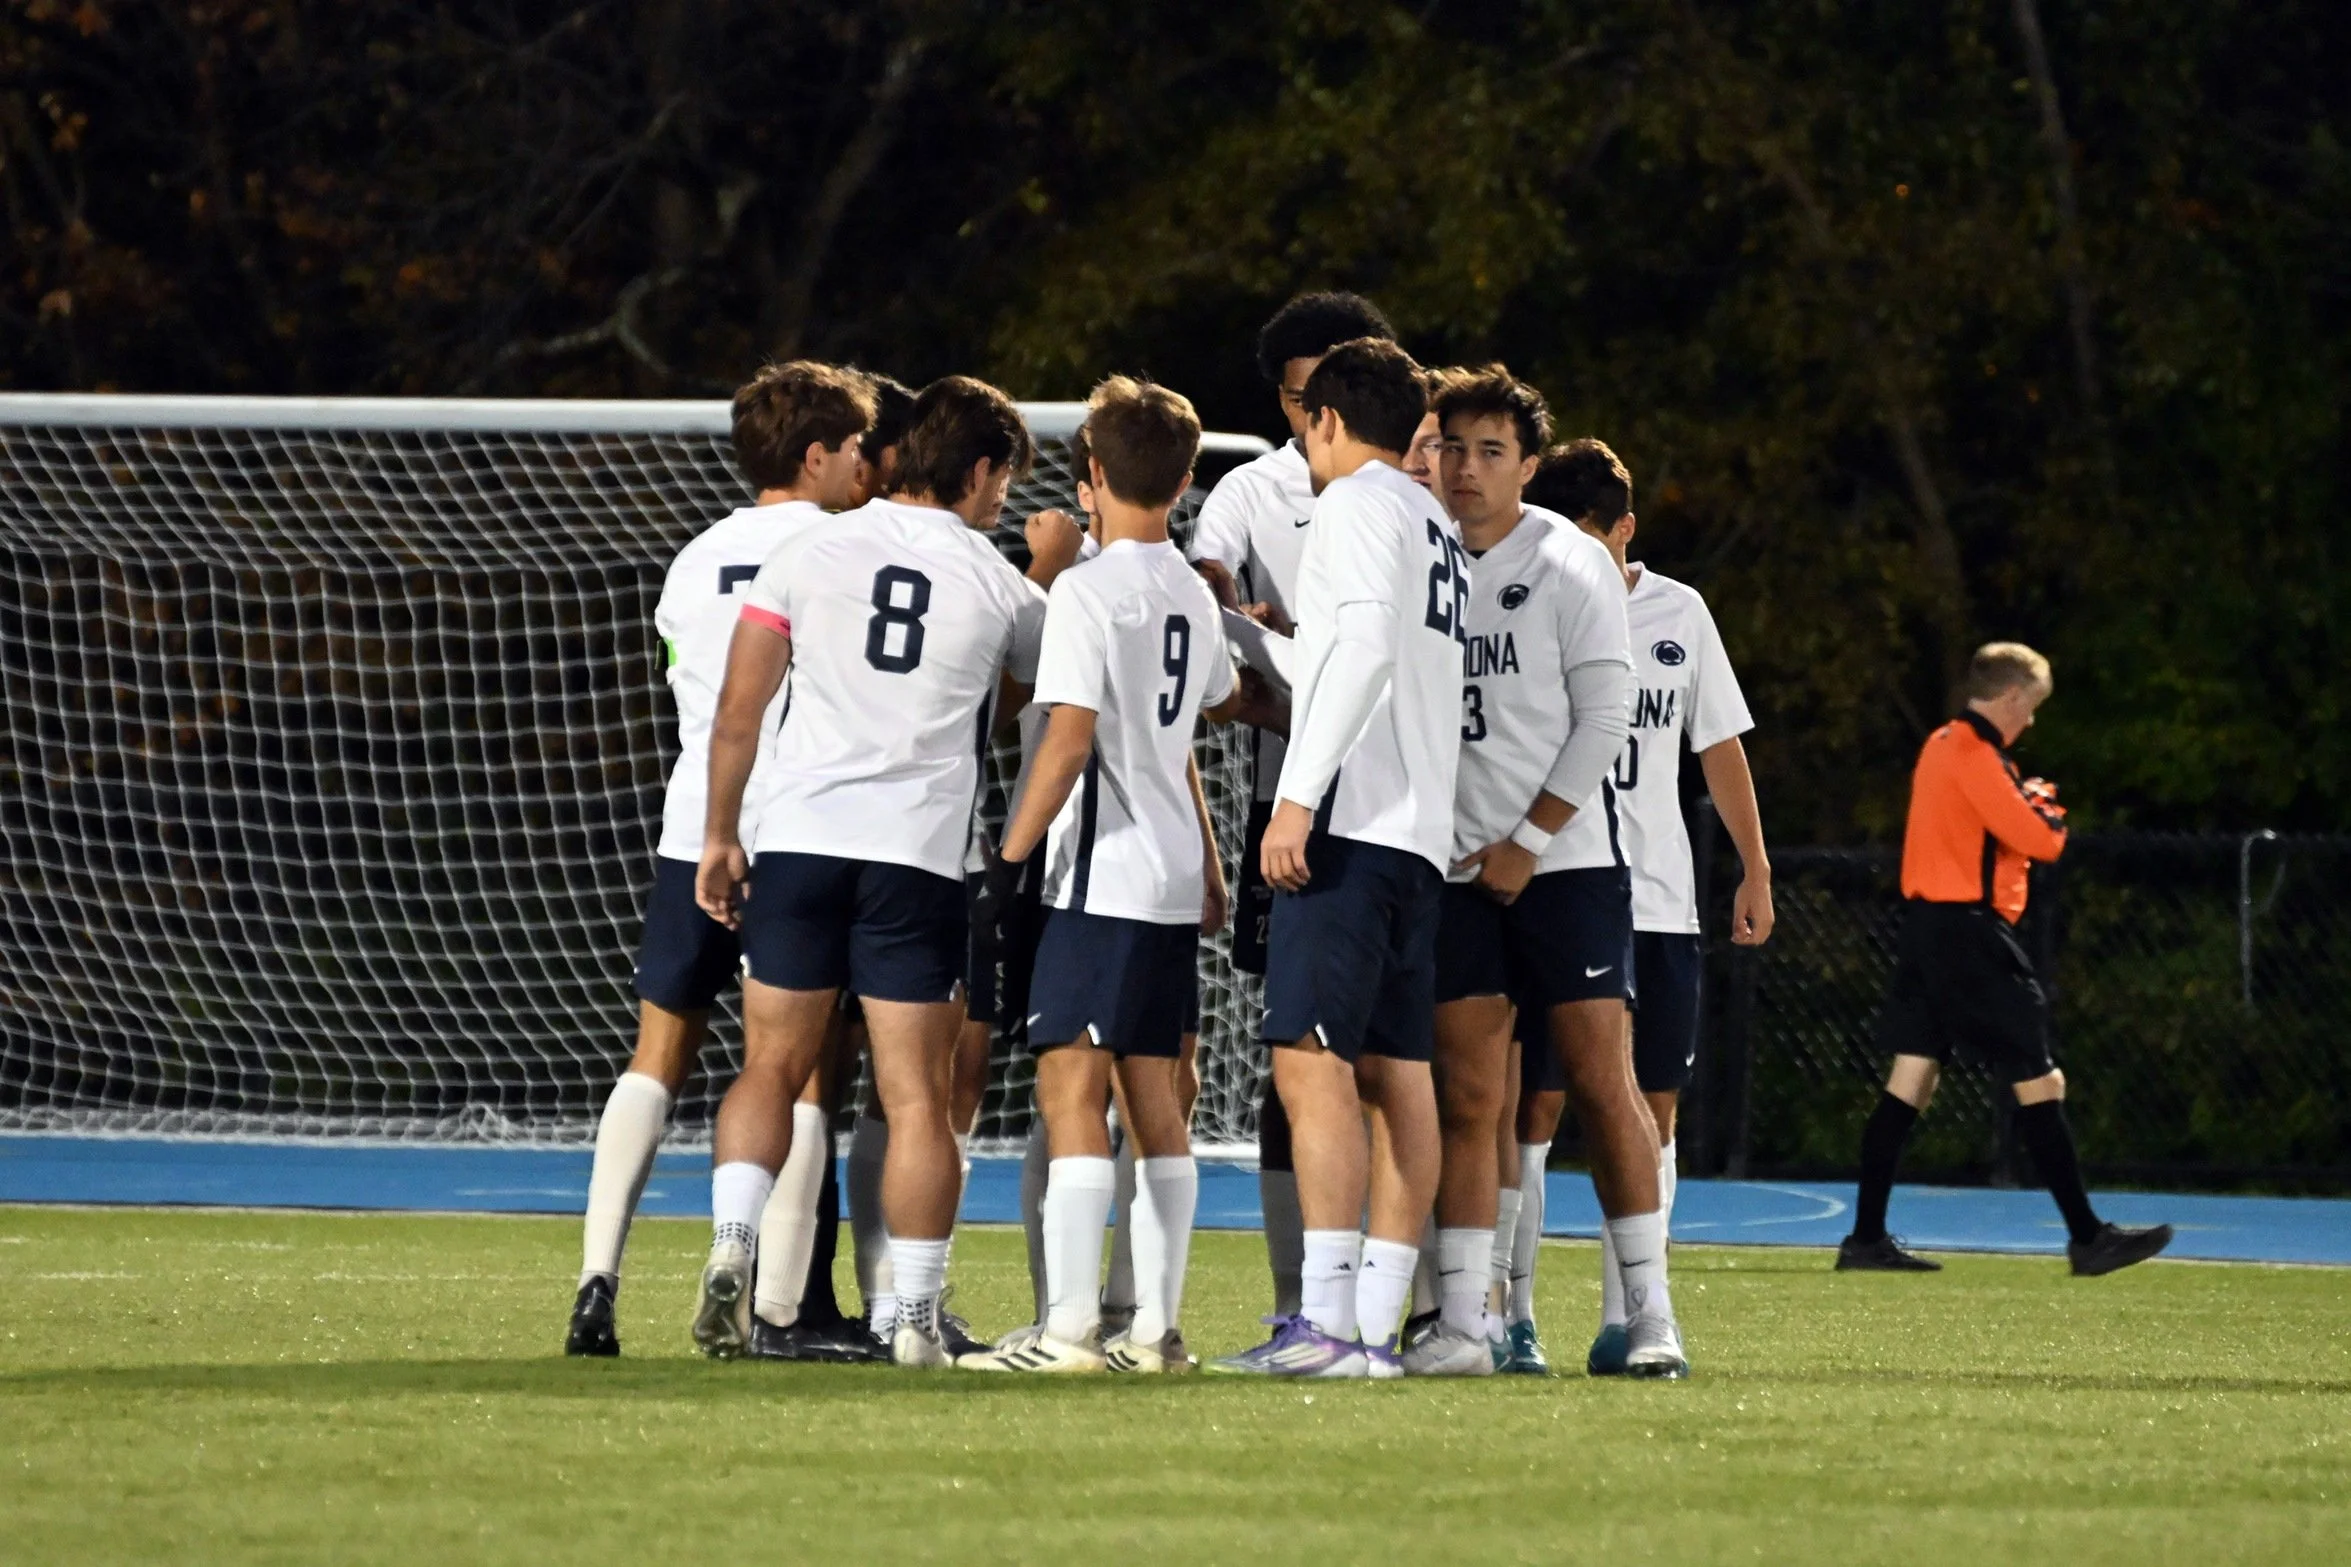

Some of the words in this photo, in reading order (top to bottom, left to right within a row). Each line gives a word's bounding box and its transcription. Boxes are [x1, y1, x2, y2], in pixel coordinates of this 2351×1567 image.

[864, 563, 932, 675] 8
[1424, 517, 1470, 644] 26
[1157, 614, 1191, 728] 9
[1461, 684, 1488, 743] 3
